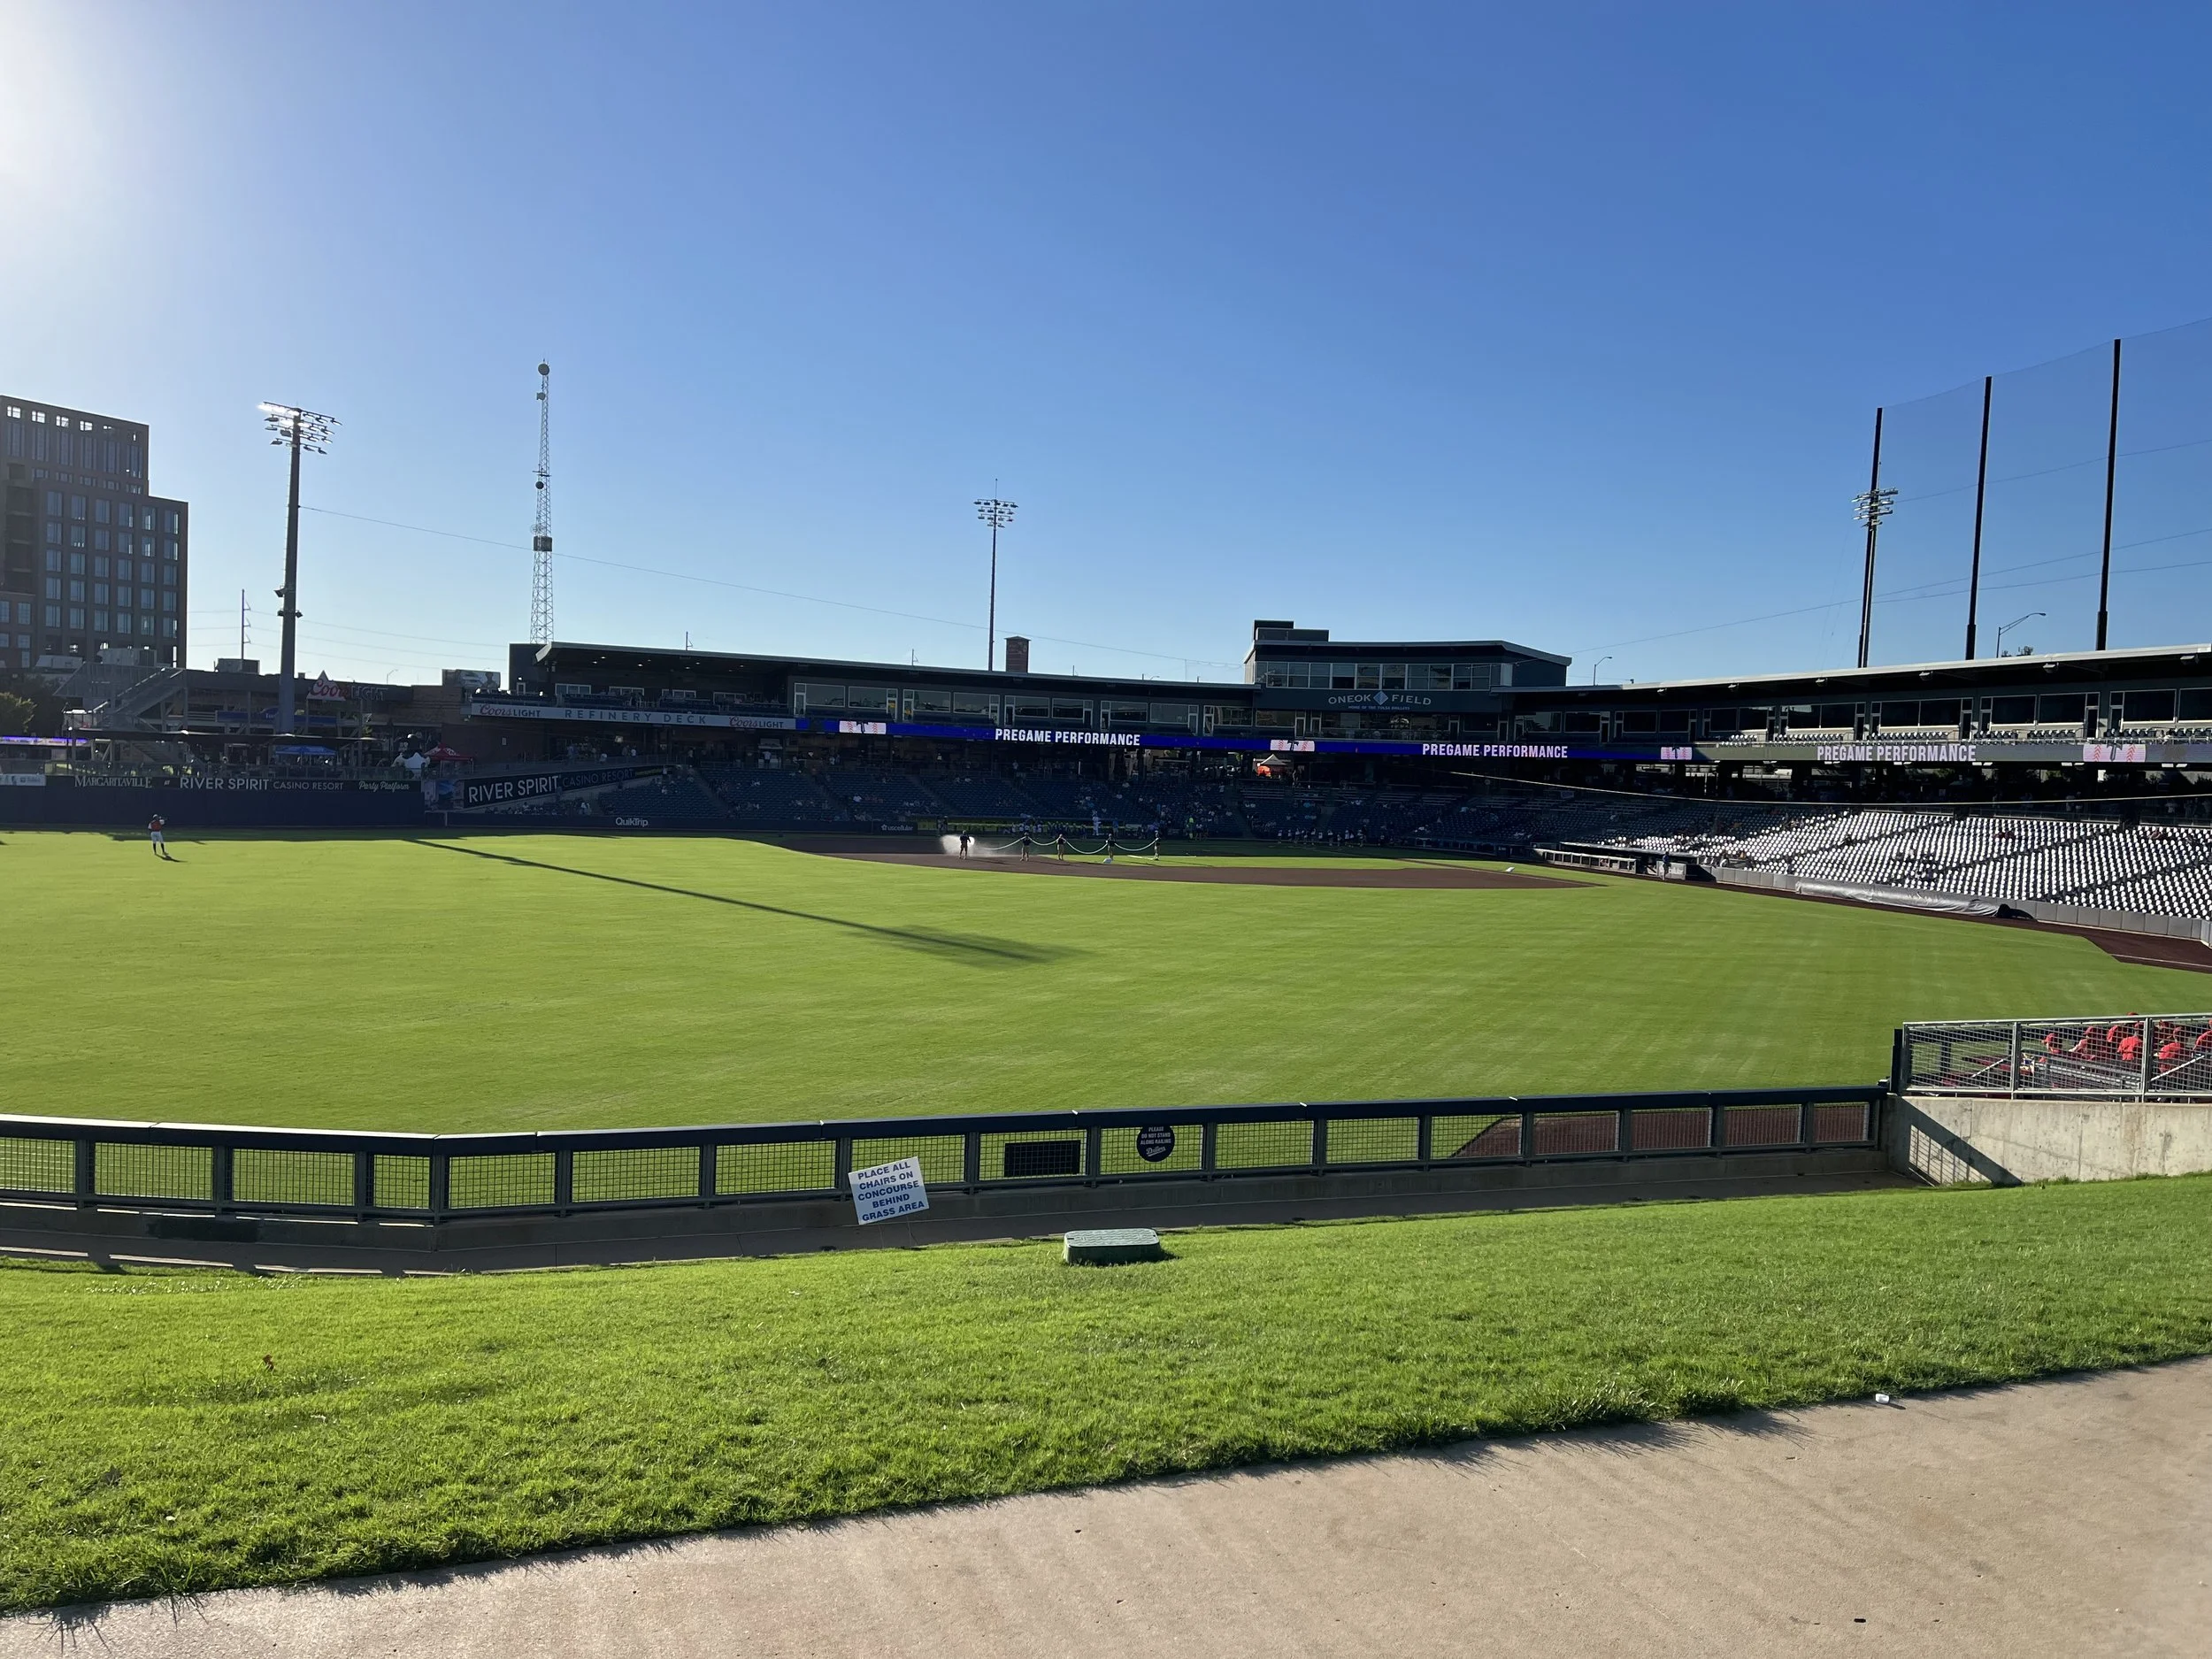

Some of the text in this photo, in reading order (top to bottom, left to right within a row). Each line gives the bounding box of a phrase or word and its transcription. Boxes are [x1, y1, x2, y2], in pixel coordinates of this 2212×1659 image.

[1328, 694, 1432, 705] ONEOK FIELD
[480, 703, 541, 718] Coors LIGHT
[565, 709, 707, 725] REFINERY DECK
[729, 715, 758, 727] Coors
[995, 728, 1141, 746] PREGAME PERFORMANCE
[1422, 743, 1568, 758] PREGAME PERFORMANCE
[1816, 745, 1977, 762] PREGAME PERFORMANCE
[74, 775, 152, 788] MARGARITAVILLE
[180, 777, 224, 789] RIVER
[228, 778, 269, 790] SPIRIT
[273, 780, 311, 790] CASINO
[311, 781, 344, 790] RESORT
[358, 780, 410, 793] Party Platform
[468, 781, 513, 803] RIVER
[518, 775, 558, 796] SPIRIT
[562, 772, 599, 787] CASINO
[602, 768, 634, 781] RESORT
[615, 817, 649, 827] QuikTrip
[857, 1161, 910, 1179] PLACE ALL
[859, 1171, 914, 1190] CHAIRS ON
[857, 1179, 920, 1201] CONCOURSE
[872, 1193, 910, 1208] BEHIND
[862, 1201, 925, 1221] GRASS AREA
